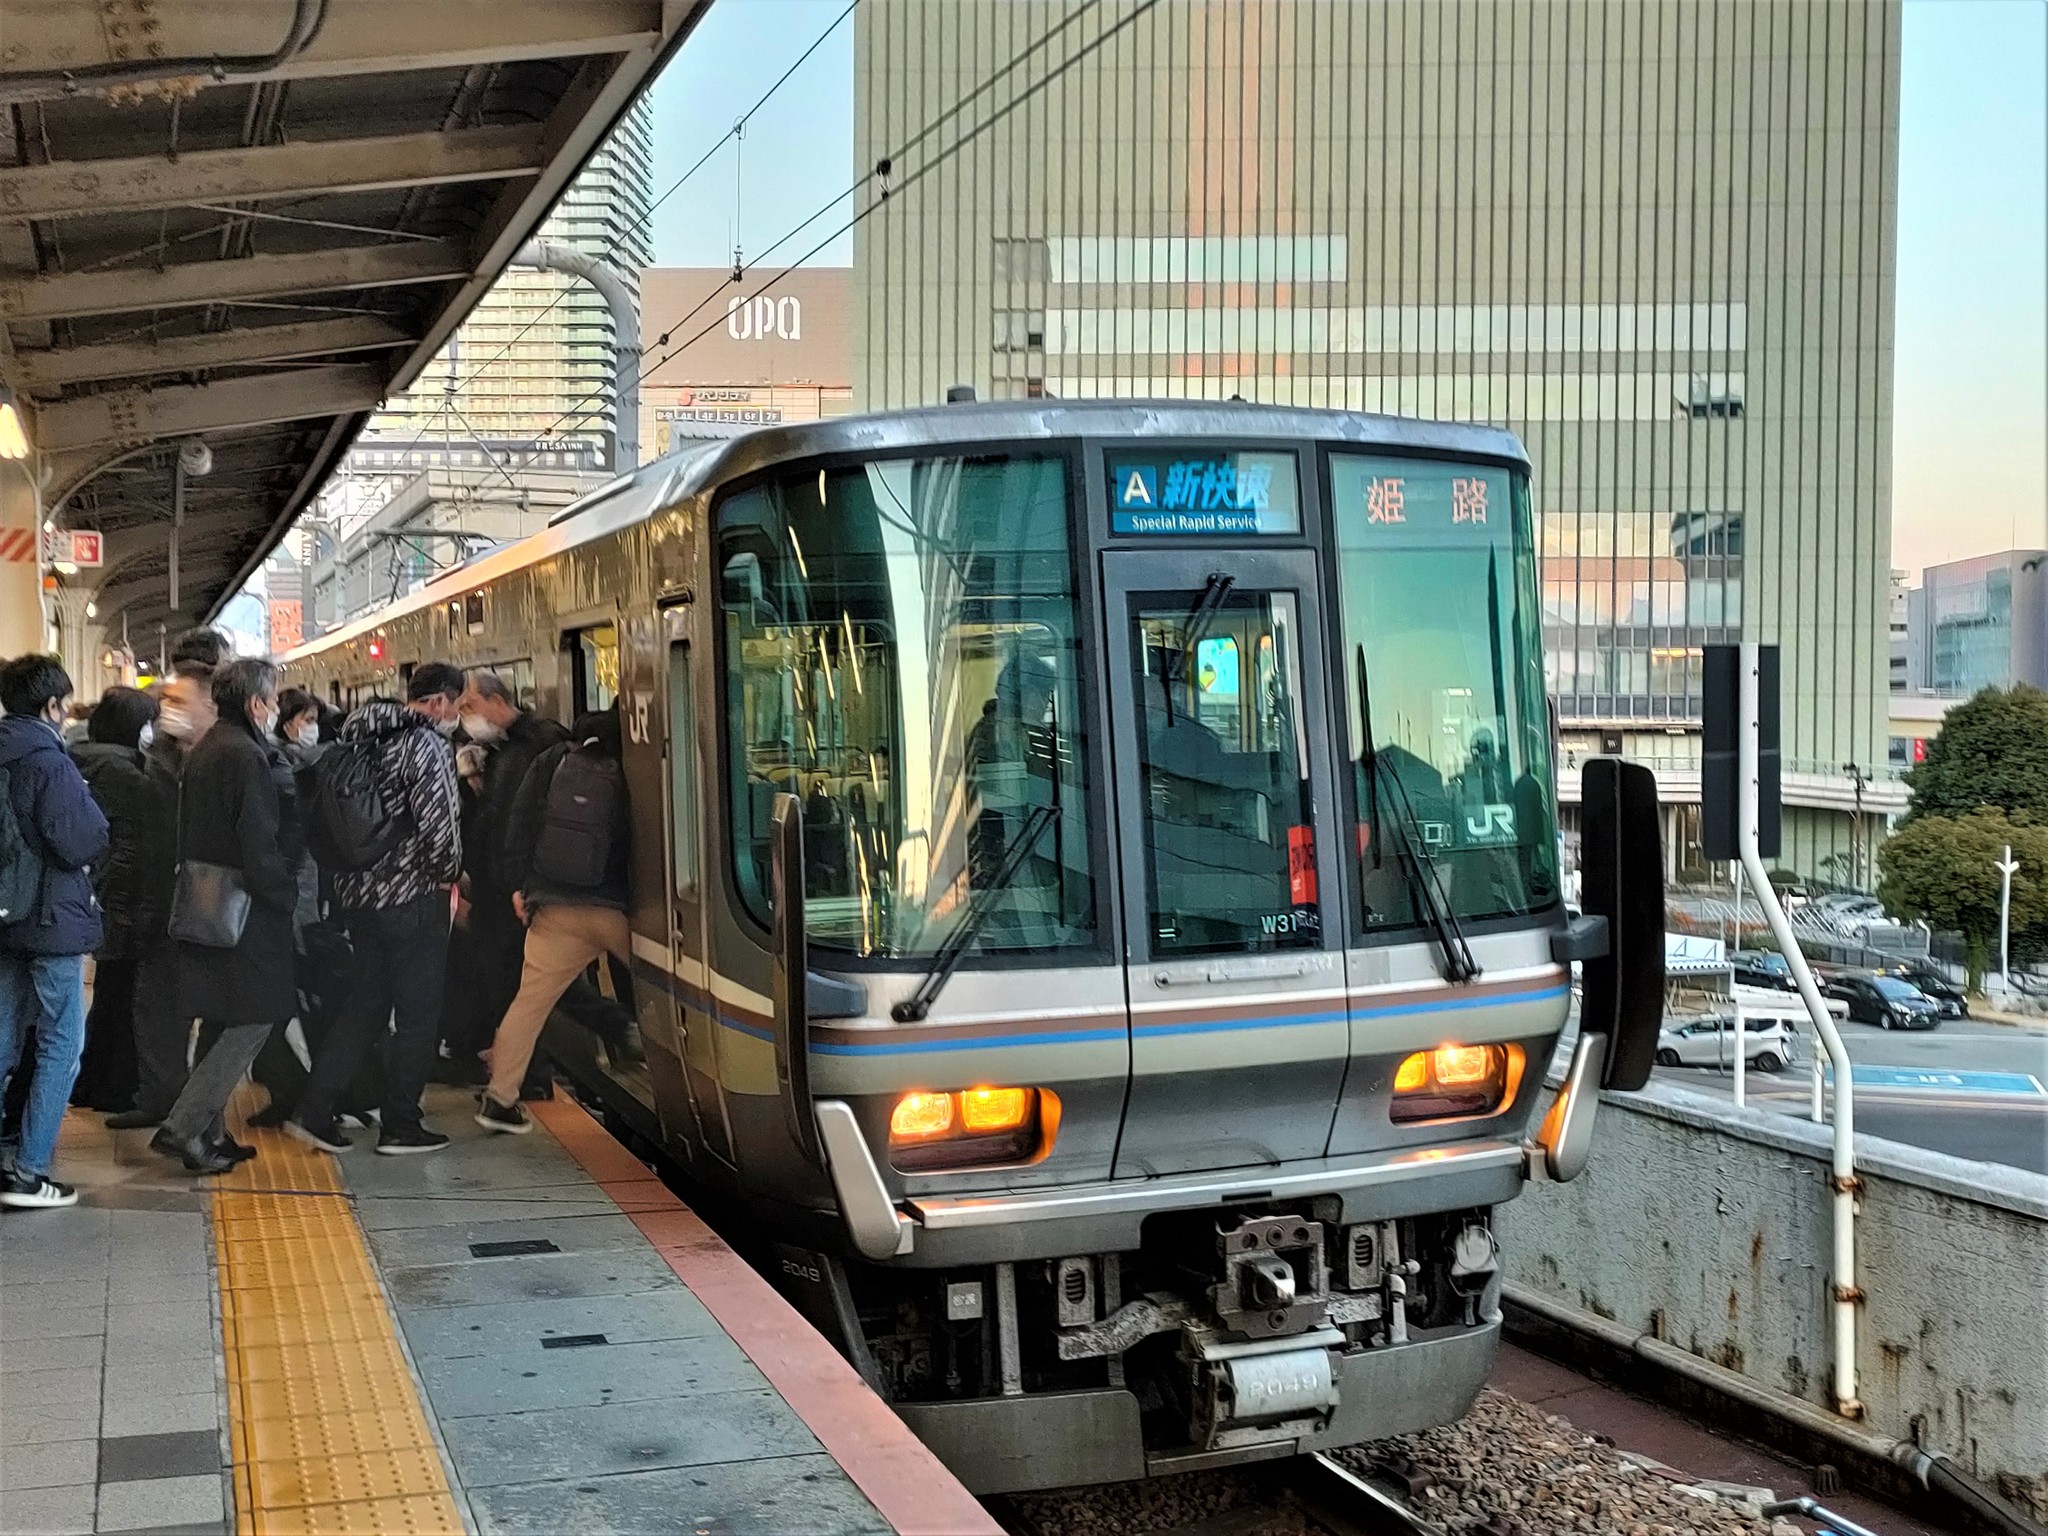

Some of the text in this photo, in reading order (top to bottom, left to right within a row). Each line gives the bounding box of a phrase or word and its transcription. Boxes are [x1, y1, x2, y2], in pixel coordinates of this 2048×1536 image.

[567, 442, 583, 450] INN
[1124, 471, 1151, 504] A
[1132, 514, 1262, 533] Special Rapid Service
[629, 690, 650, 744] JR
[1467, 804, 1517, 840] JR
